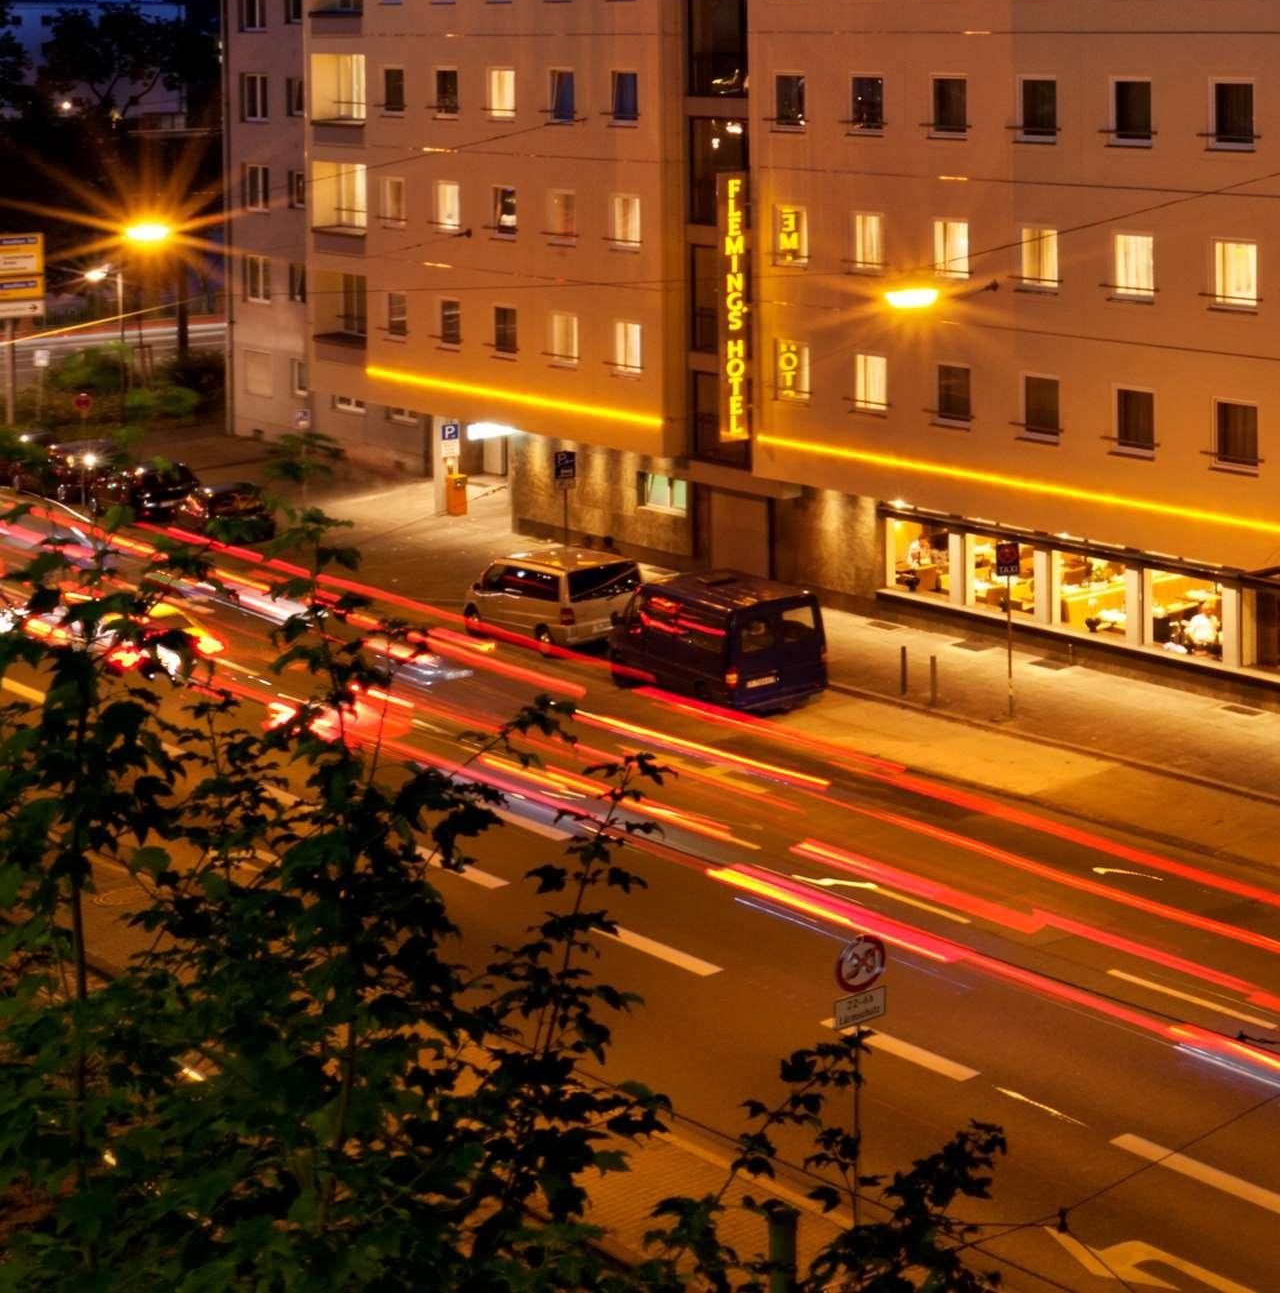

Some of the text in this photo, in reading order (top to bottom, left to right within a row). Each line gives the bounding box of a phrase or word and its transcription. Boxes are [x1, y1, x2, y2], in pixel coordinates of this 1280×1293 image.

[725, 179, 748, 435] FLEMING'S HOTEL
[444, 425, 455, 439] P
[1000, 565, 1018, 573] TAXI
[847, 948, 876, 980] 30
